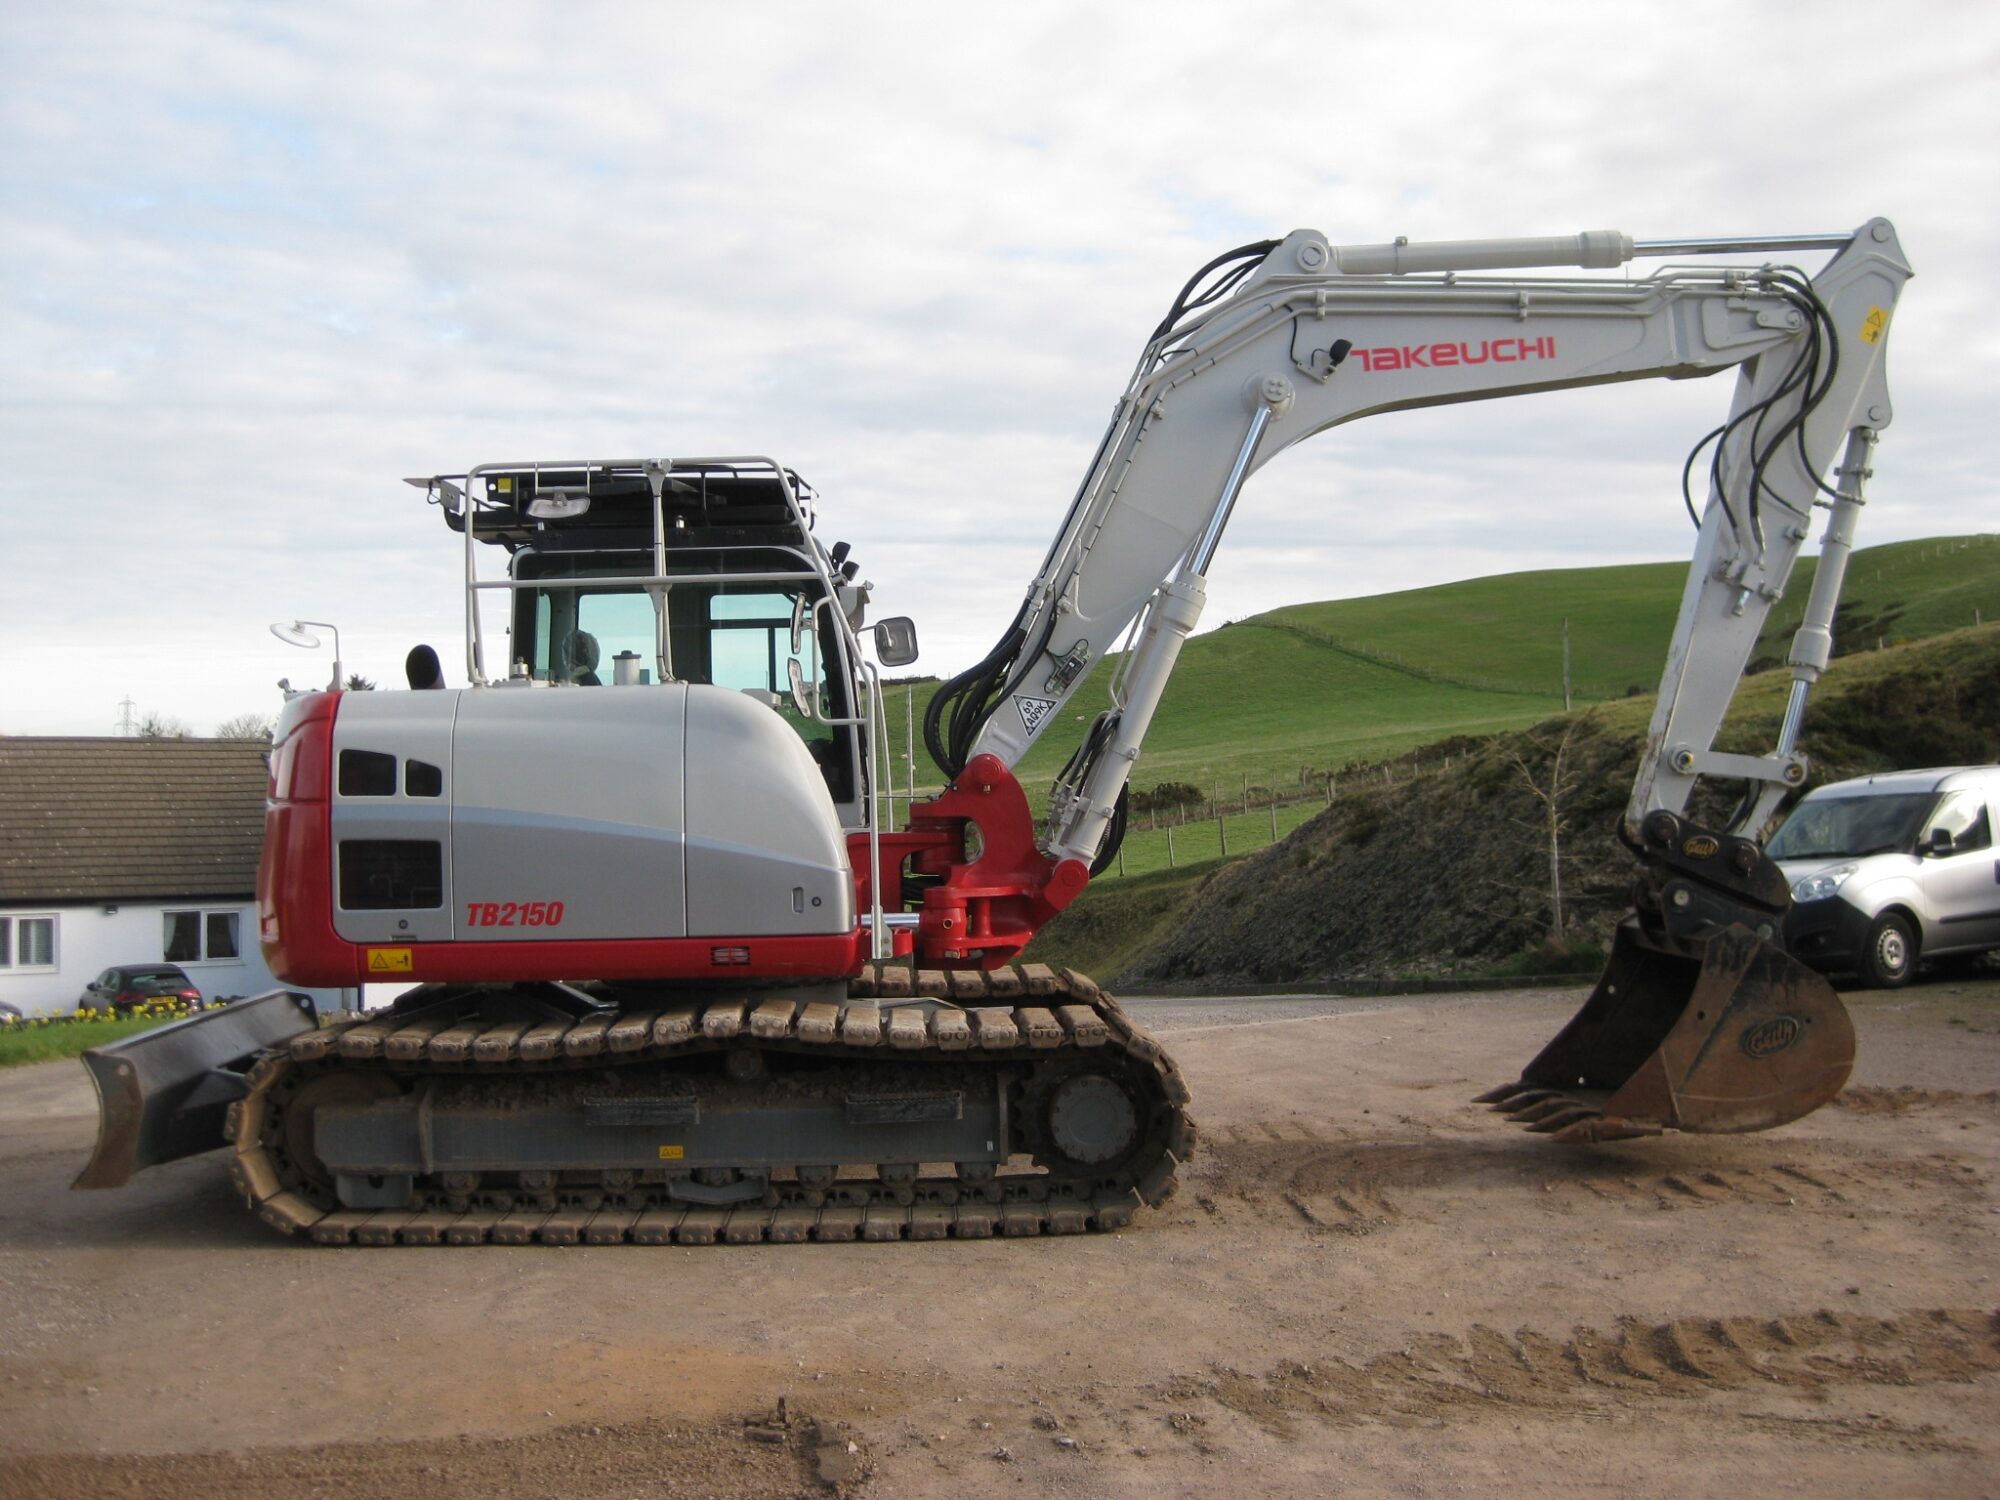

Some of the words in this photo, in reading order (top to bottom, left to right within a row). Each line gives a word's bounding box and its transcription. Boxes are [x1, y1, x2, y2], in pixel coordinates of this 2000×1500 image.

[1022, 701, 1034, 714] 69
[1026, 702, 1047, 725] AQ9K
[467, 901, 564, 927] TB2150
